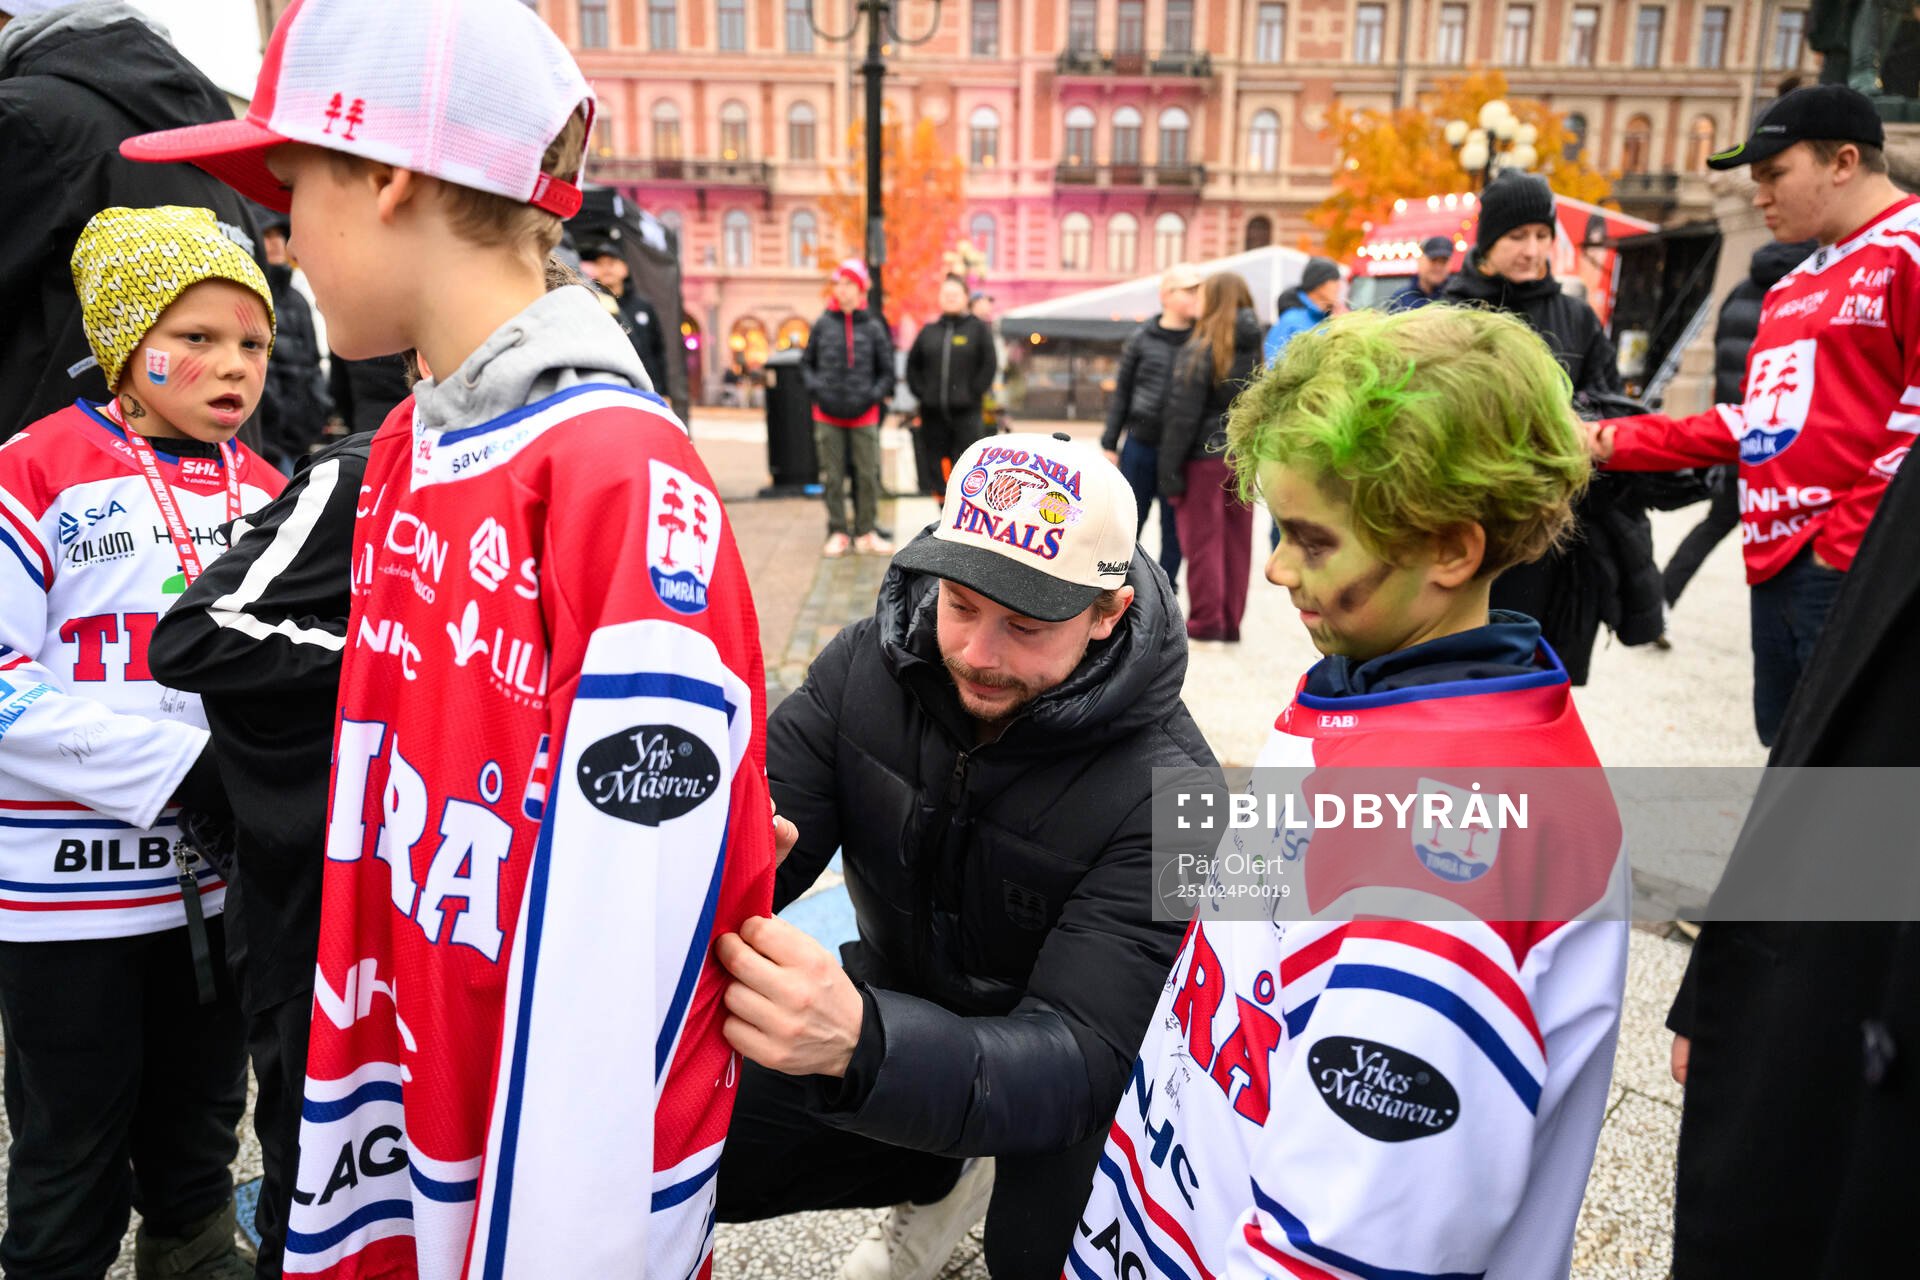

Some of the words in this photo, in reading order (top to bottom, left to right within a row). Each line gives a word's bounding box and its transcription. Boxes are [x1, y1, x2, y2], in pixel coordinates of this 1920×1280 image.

[182, 460, 220, 477] SHL
[973, 446, 1030, 469] 1990
[1029, 453, 1082, 501] NBA
[953, 496, 1065, 560] FINALS
[658, 576, 695, 603] TIMRÅ
[1320, 714, 1355, 729] EAB
[1341, 1044, 1413, 1095] Yrkes
[1320, 1068, 1444, 1128] Mästaren
